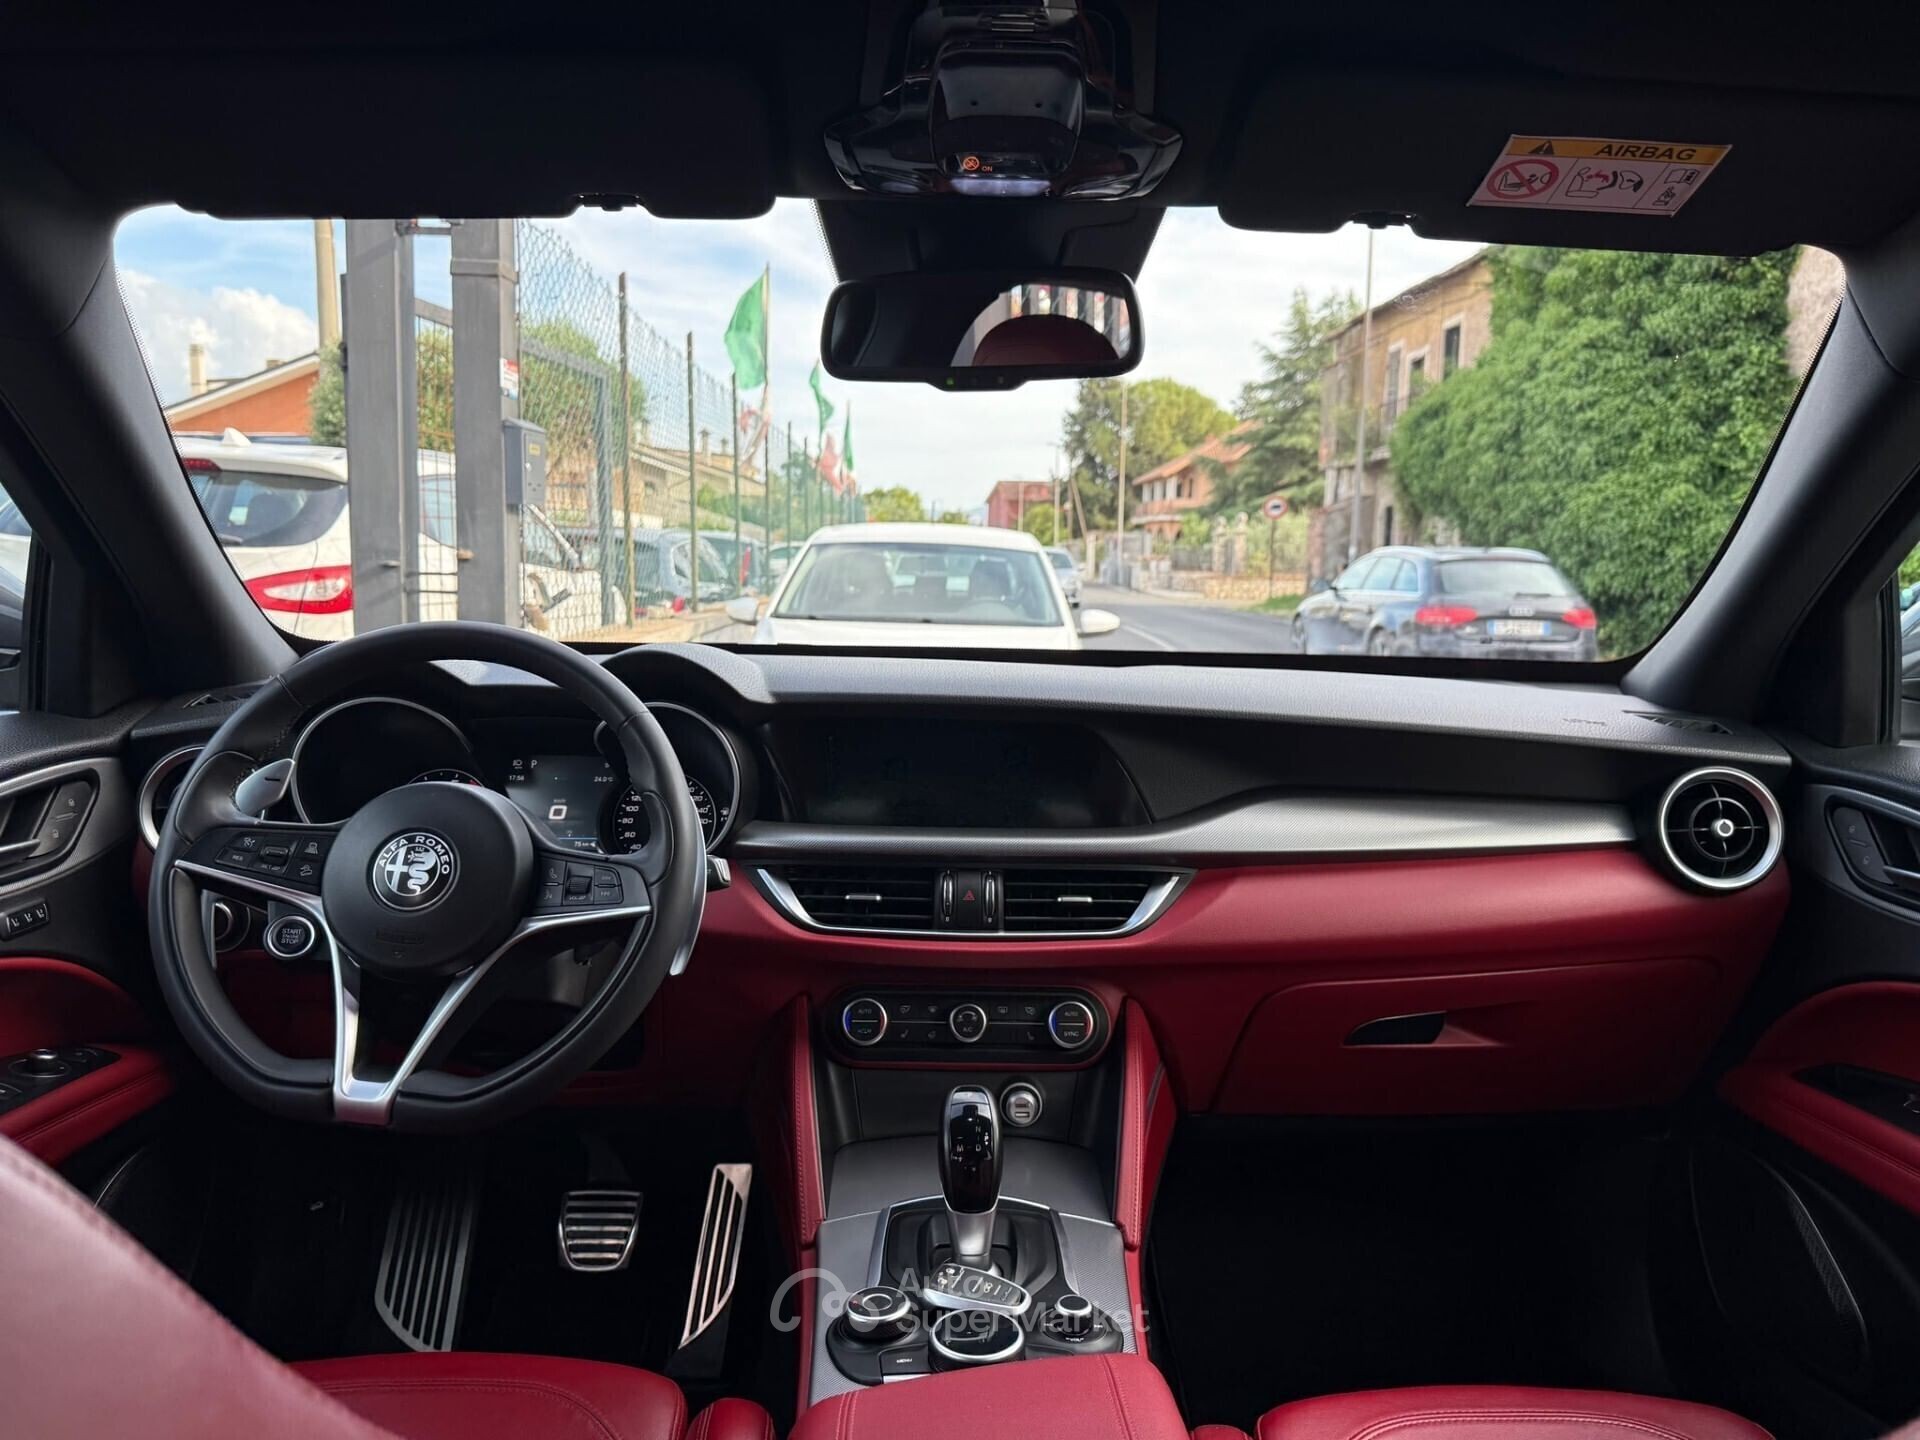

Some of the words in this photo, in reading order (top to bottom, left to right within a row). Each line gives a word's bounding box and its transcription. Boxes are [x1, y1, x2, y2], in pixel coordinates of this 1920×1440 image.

[1594, 143, 1698, 161] AIRBAG
[981, 165, 993, 173] ON
[530, 760, 538, 769] P
[622, 817, 634, 825] 80
[379, 838, 409, 868] ALFA
[415, 835, 451, 875] ROMEO
